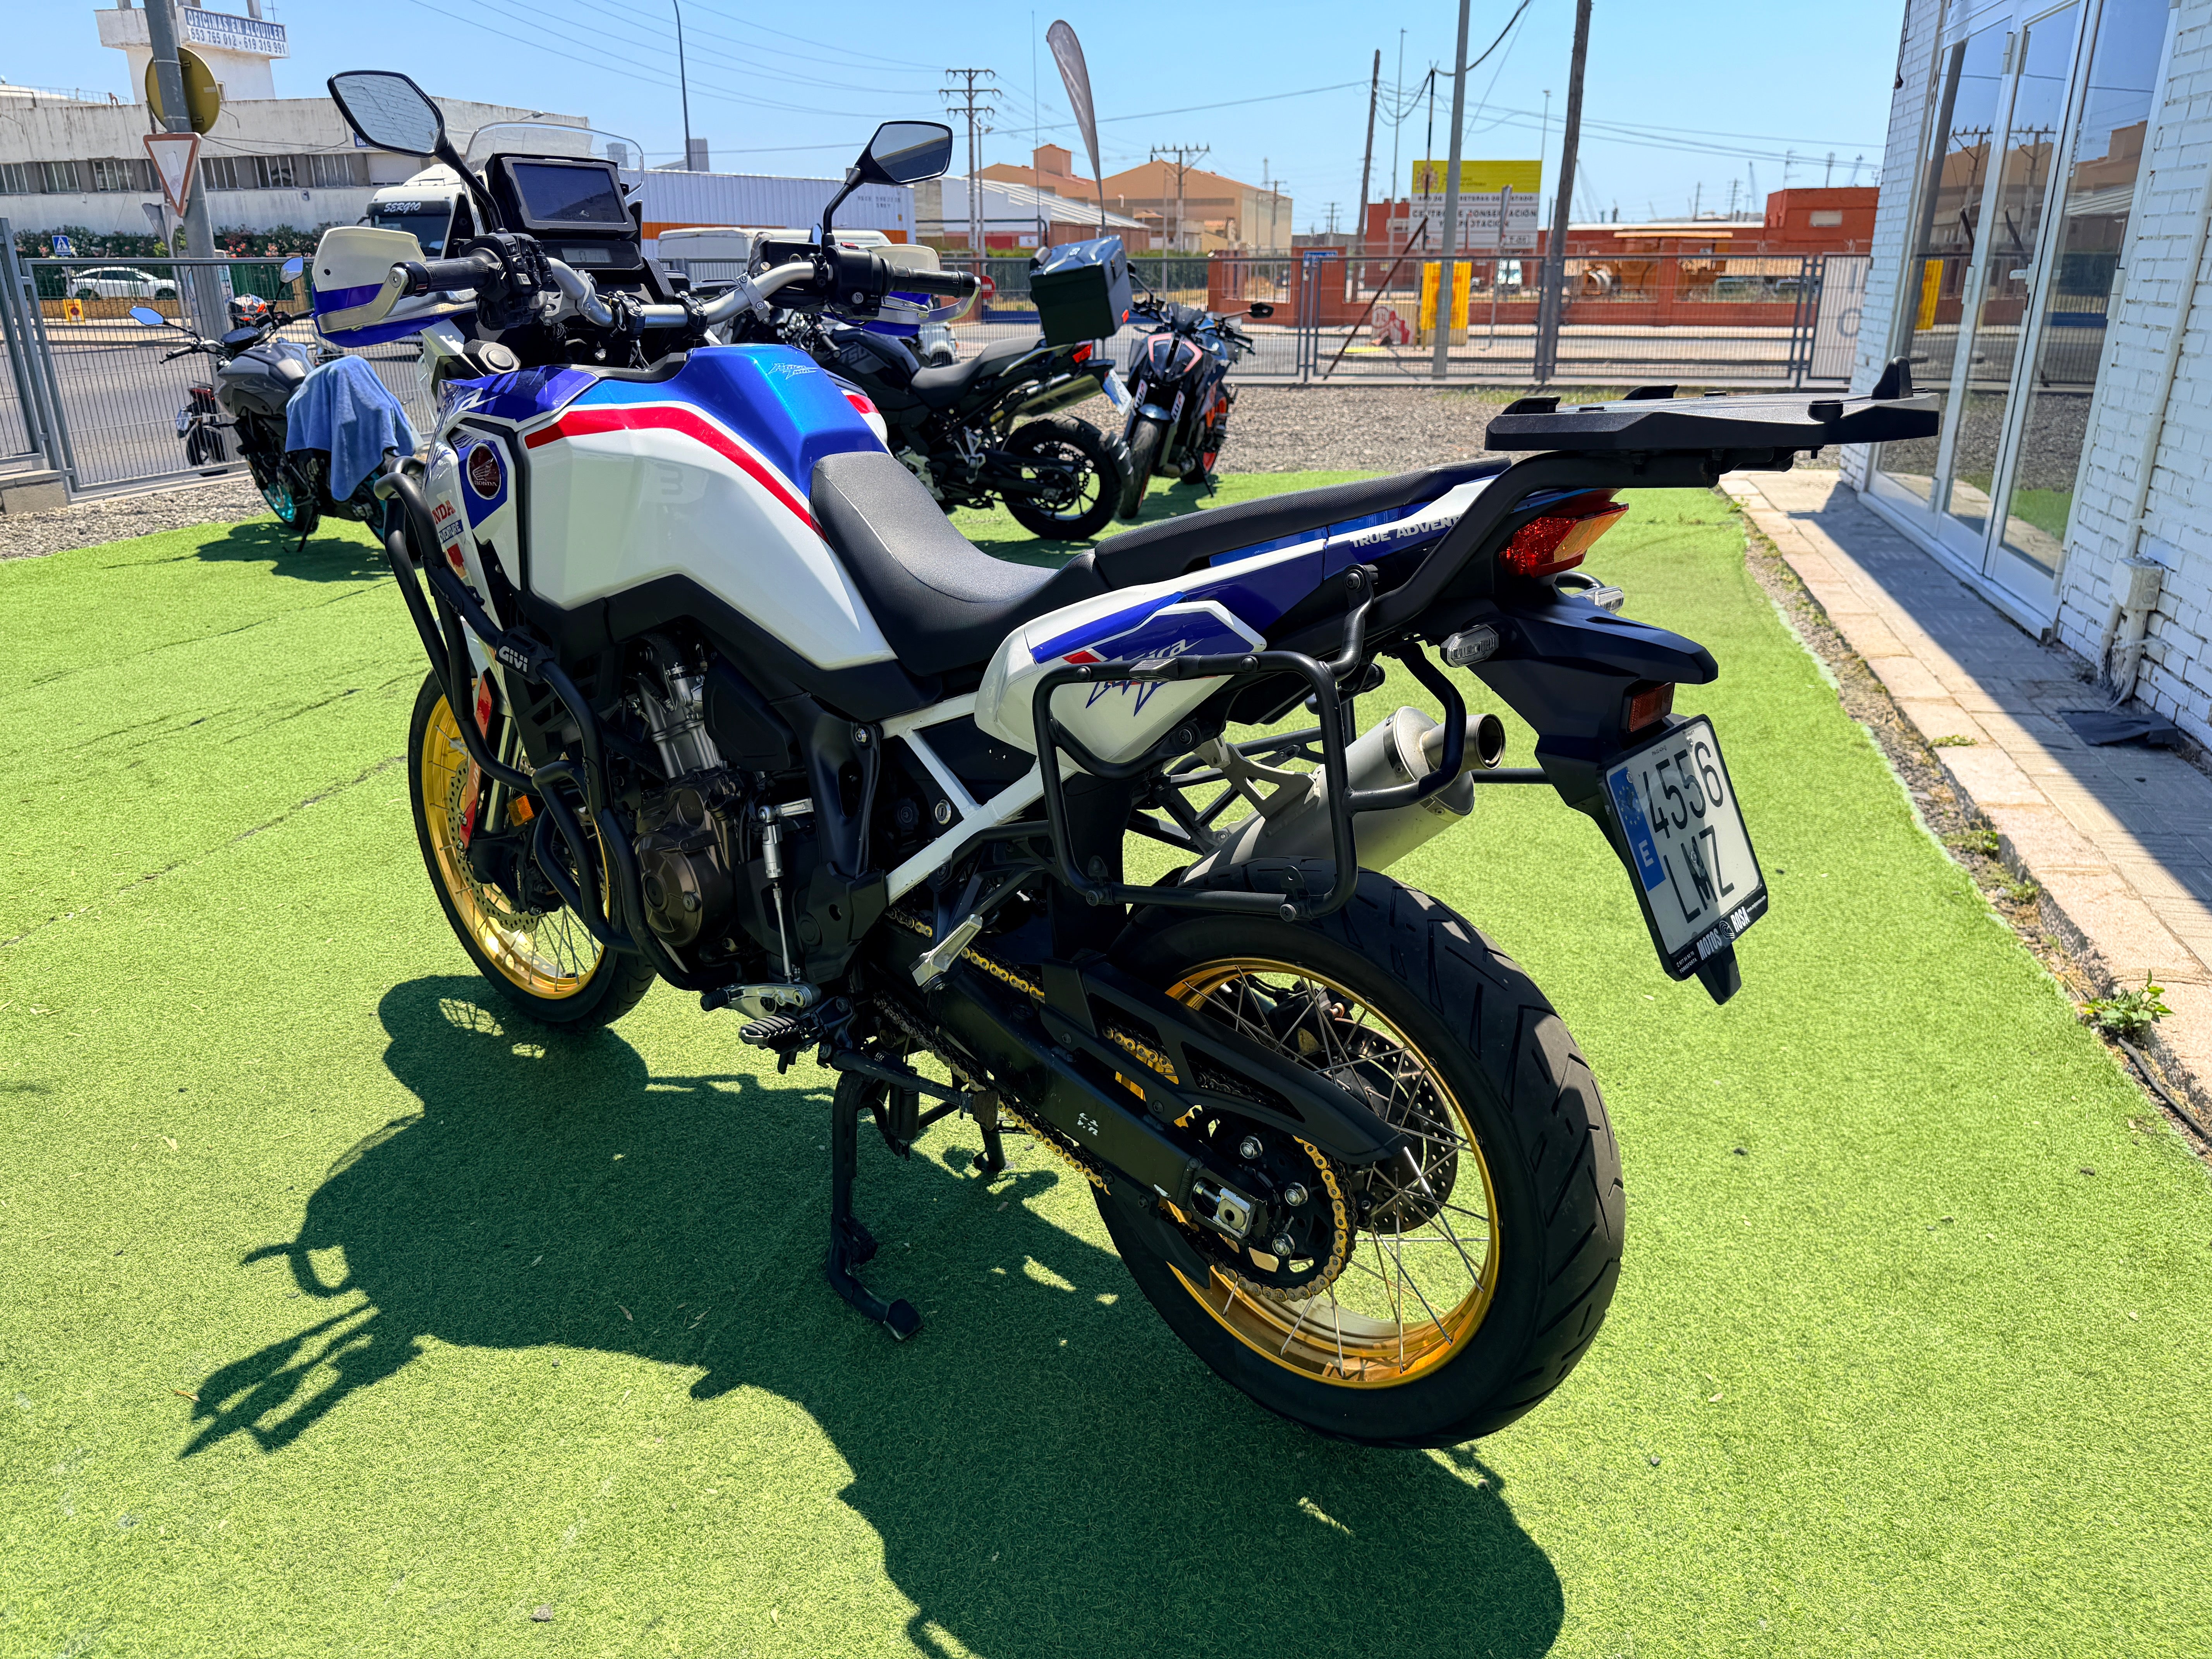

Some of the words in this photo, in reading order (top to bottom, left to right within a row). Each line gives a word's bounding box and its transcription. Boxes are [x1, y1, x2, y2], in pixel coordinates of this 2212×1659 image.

[187, 10, 228, 32] OFICINAS
[231, 19, 243, 34] EN
[245, 22, 284, 41] ALQUILER
[191, 27, 204, 41] 653
[207, 31, 221, 45] 765
[223, 33, 237, 46] 012
[244, 37, 256, 50] 619
[259, 40, 271, 52] 319
[273, 42, 285, 54] 991
[384, 202, 421, 214] SERGIO
[432, 500, 456, 525] NDA
[1349, 531, 1391, 548] TRUE
[1396, 517, 1460, 539] ADVENT
[499, 646, 528, 672] GIVI
[1643, 741, 1723, 839] 4556
[1638, 839, 1654, 867] E
[1664, 825, 1735, 924] LMZ
[1696, 928, 1722, 961] MOTOS
[1730, 906, 1750, 933] ROSA
